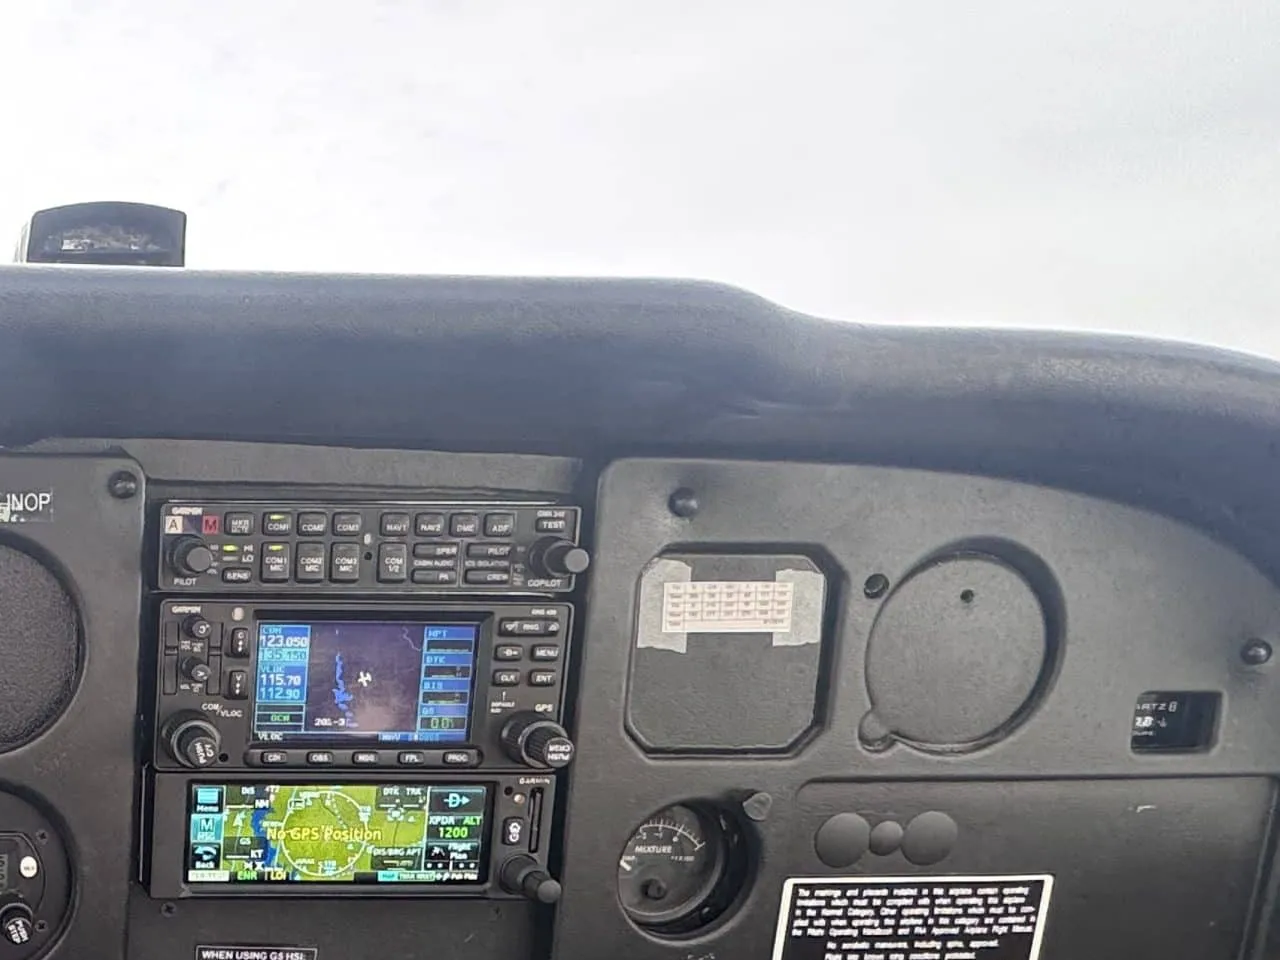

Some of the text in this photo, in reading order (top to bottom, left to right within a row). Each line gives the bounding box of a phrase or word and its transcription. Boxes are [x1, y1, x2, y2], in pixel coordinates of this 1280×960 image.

[7, 493, 51, 512] INOP
[168, 520, 179, 531] A
[205, 519, 217, 531] M
[268, 523, 289, 531] COM1
[492, 525, 510, 533] ADF
[543, 521, 564, 529] TEST
[174, 577, 197, 586] PILOT
[528, 579, 562, 588] COPILOT
[260, 636, 308, 647] 123.050
[260, 674, 301, 686] 115.70
[260, 688, 300, 700] 112.90
[535, 704, 553, 712] GPS
[200, 818, 214, 832] M
[429, 816, 481, 825] XPDR ALT
[267, 827, 382, 840] No GPS Position
[439, 827, 468, 838] 1200
[634, 845, 672, 853] MIXTURE
[195, 861, 215, 869] Back
[237, 871, 258, 880] ENR
[202, 950, 233, 960] WHEN
[235, 951, 267, 960] USING
